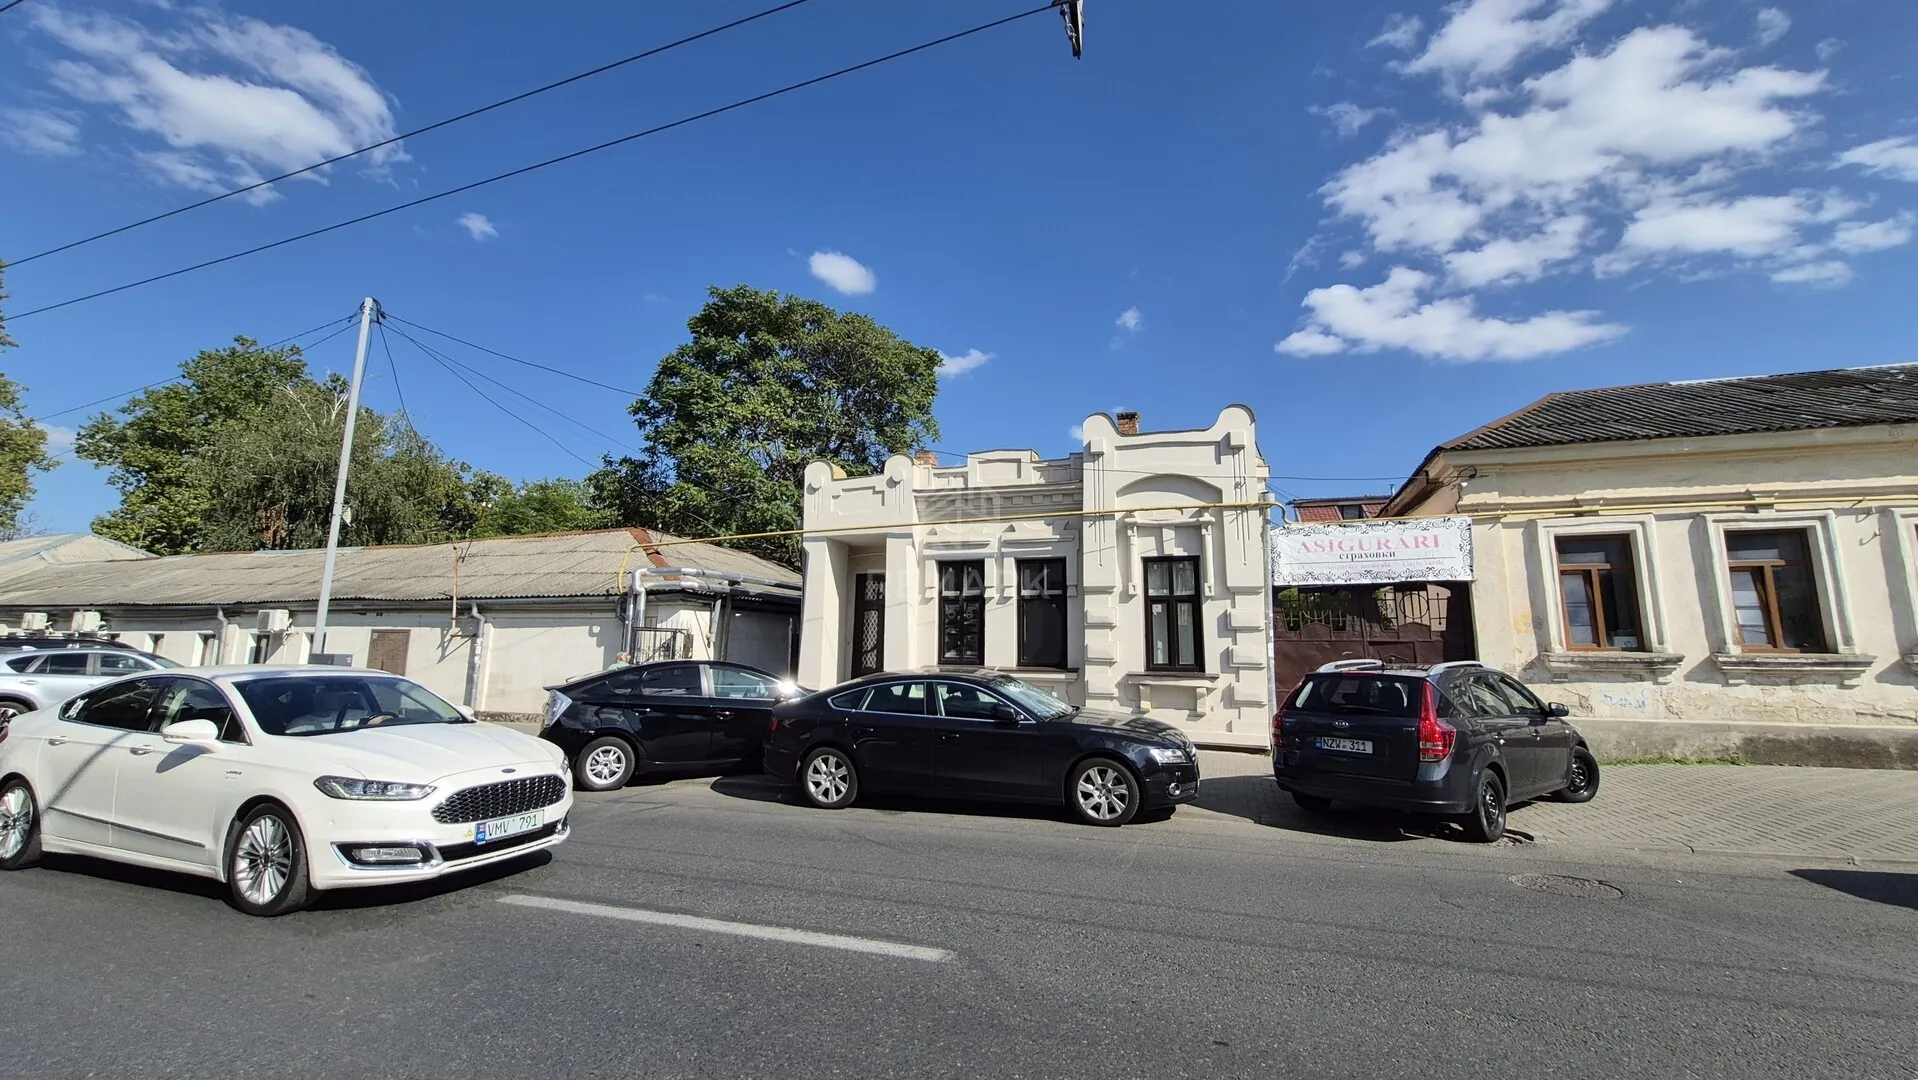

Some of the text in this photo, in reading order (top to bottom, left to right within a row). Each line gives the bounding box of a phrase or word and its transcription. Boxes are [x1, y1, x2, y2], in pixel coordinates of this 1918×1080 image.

[1297, 535, 1440, 553] ASIGURARI
[1339, 551, 1396, 562] страховки
[1323, 738, 1341, 749] NZW
[1349, 740, 1367, 752] 311
[488, 821, 509, 837] VMV
[519, 815, 537, 829] 791
